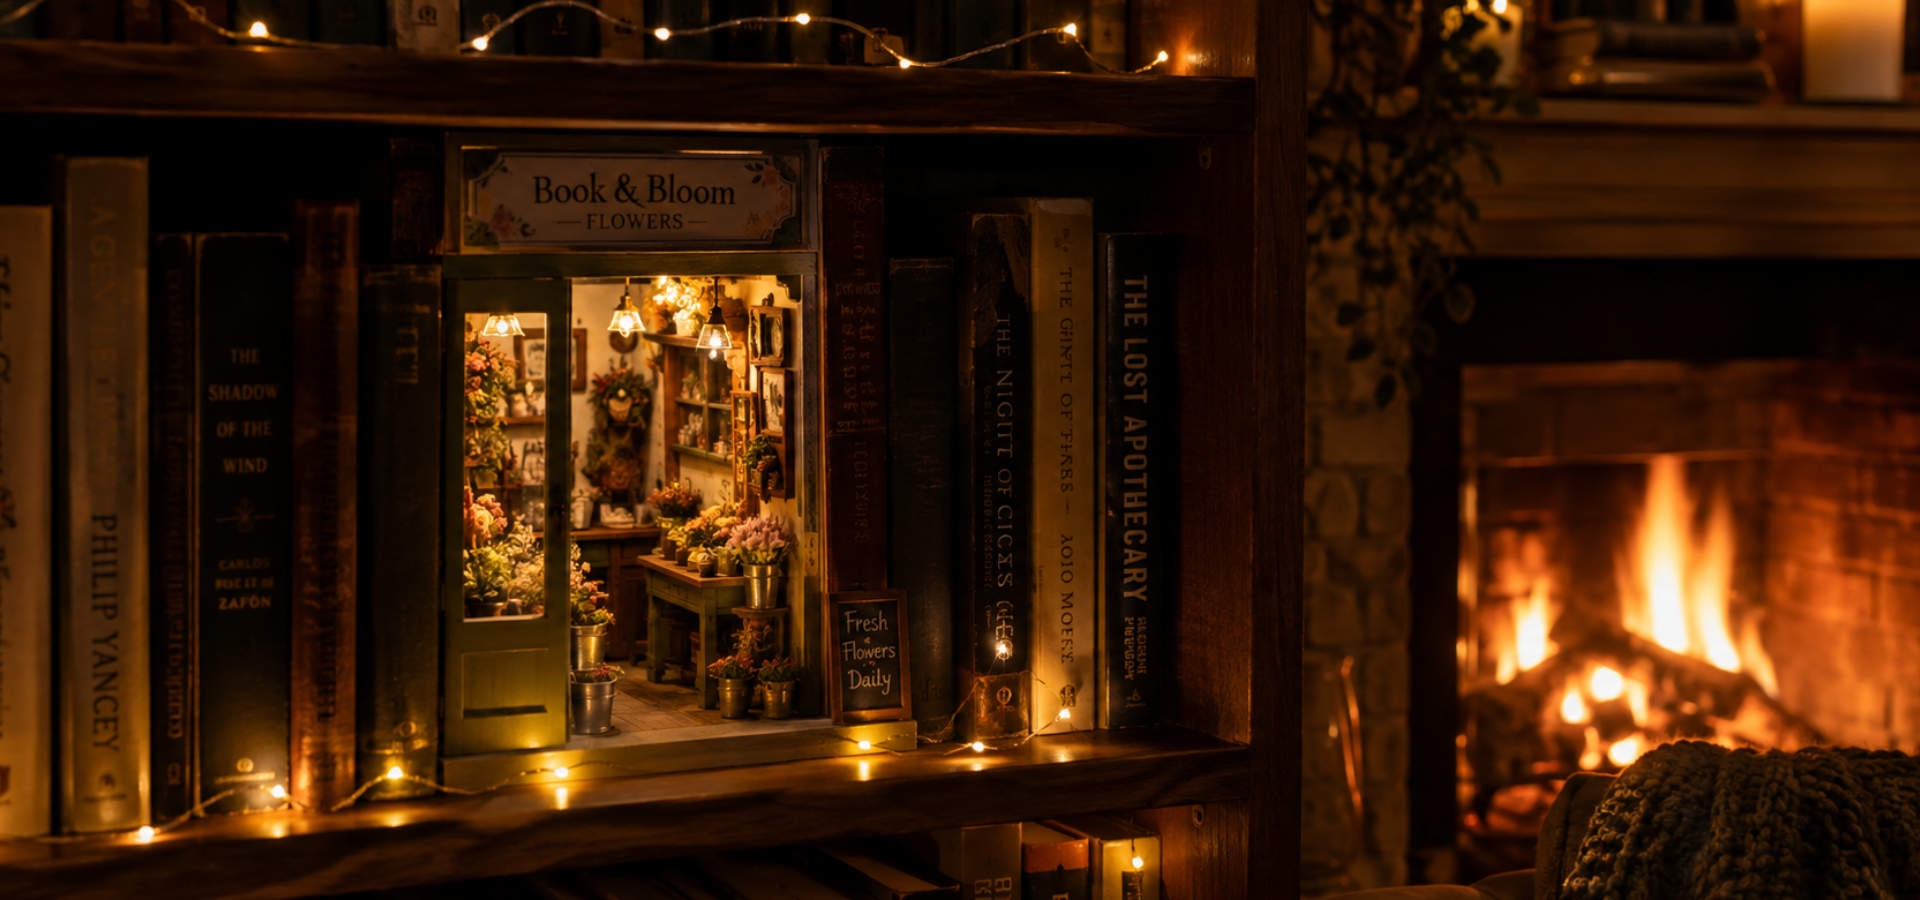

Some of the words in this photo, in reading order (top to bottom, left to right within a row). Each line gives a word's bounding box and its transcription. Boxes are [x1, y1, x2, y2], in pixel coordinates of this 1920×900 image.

[534, 172, 607, 204] Book
[614, 173, 646, 208] &
[647, 173, 736, 205] Bloom
[587, 213, 683, 230] FLOWERS
[1060, 267, 1073, 308] THE
[1122, 274, 1149, 328] THE
[997, 313, 1011, 358] THE
[229, 347, 262, 365] THE
[1122, 336, 1149, 404] LOST
[208, 383, 281, 402] SHADOW
[1060, 393, 1073, 421] OF
[216, 421, 238, 439] OF
[242, 421, 273, 439] THE
[222, 456, 269, 474] WIND
[997, 469, 1012, 499] OF
[1122, 414, 1149, 604] APOTHECARY
[92, 514, 119, 620] PHILIP
[844, 609, 889, 633] Fresh
[842, 640, 896, 661] Flowers
[92, 631, 119, 753] YANCEY
[847, 667, 892, 697] Daily
